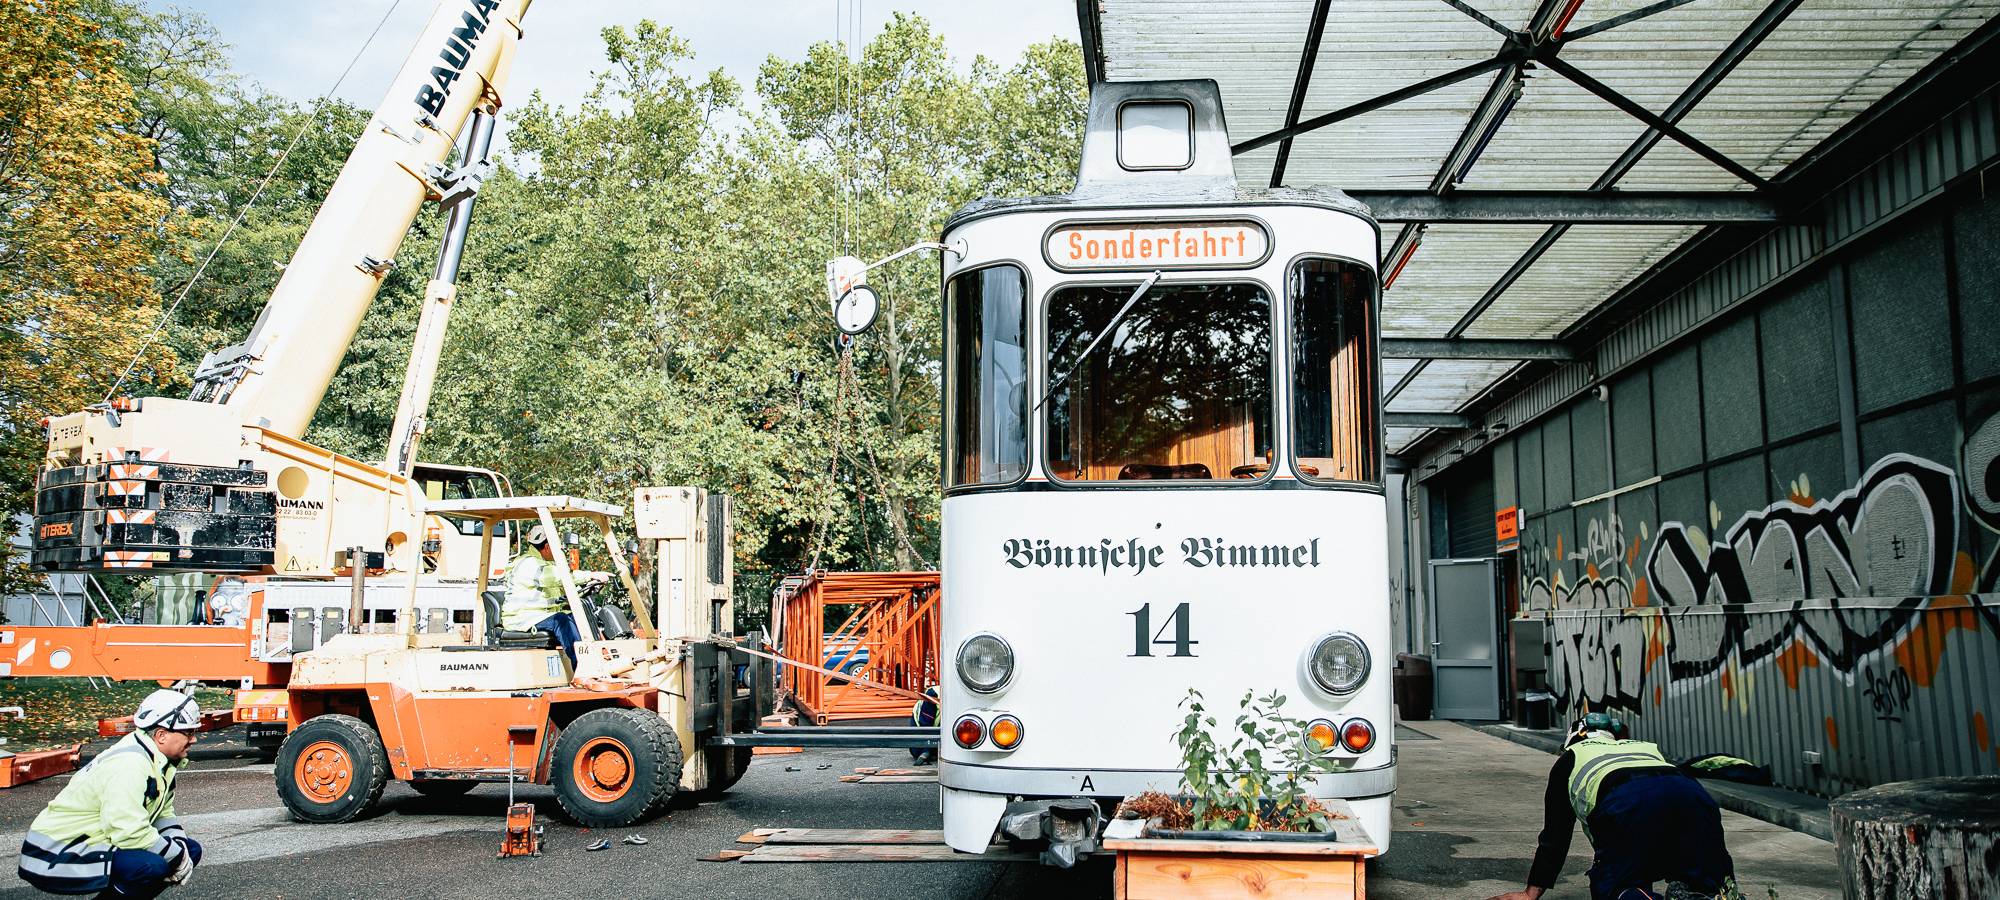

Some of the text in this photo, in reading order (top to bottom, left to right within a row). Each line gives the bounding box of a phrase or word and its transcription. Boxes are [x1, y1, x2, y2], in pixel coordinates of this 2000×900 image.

[414, 0, 502, 118] BAUMA
[1069, 230, 1246, 260] Sonderfahrt
[46, 521, 74, 537] TEREX
[1181, 537, 1320, 569] Bimmel
[1126, 602, 1199, 658] 14
[440, 663, 489, 671] BAUMANN
[1079, 774, 1095, 792] A
